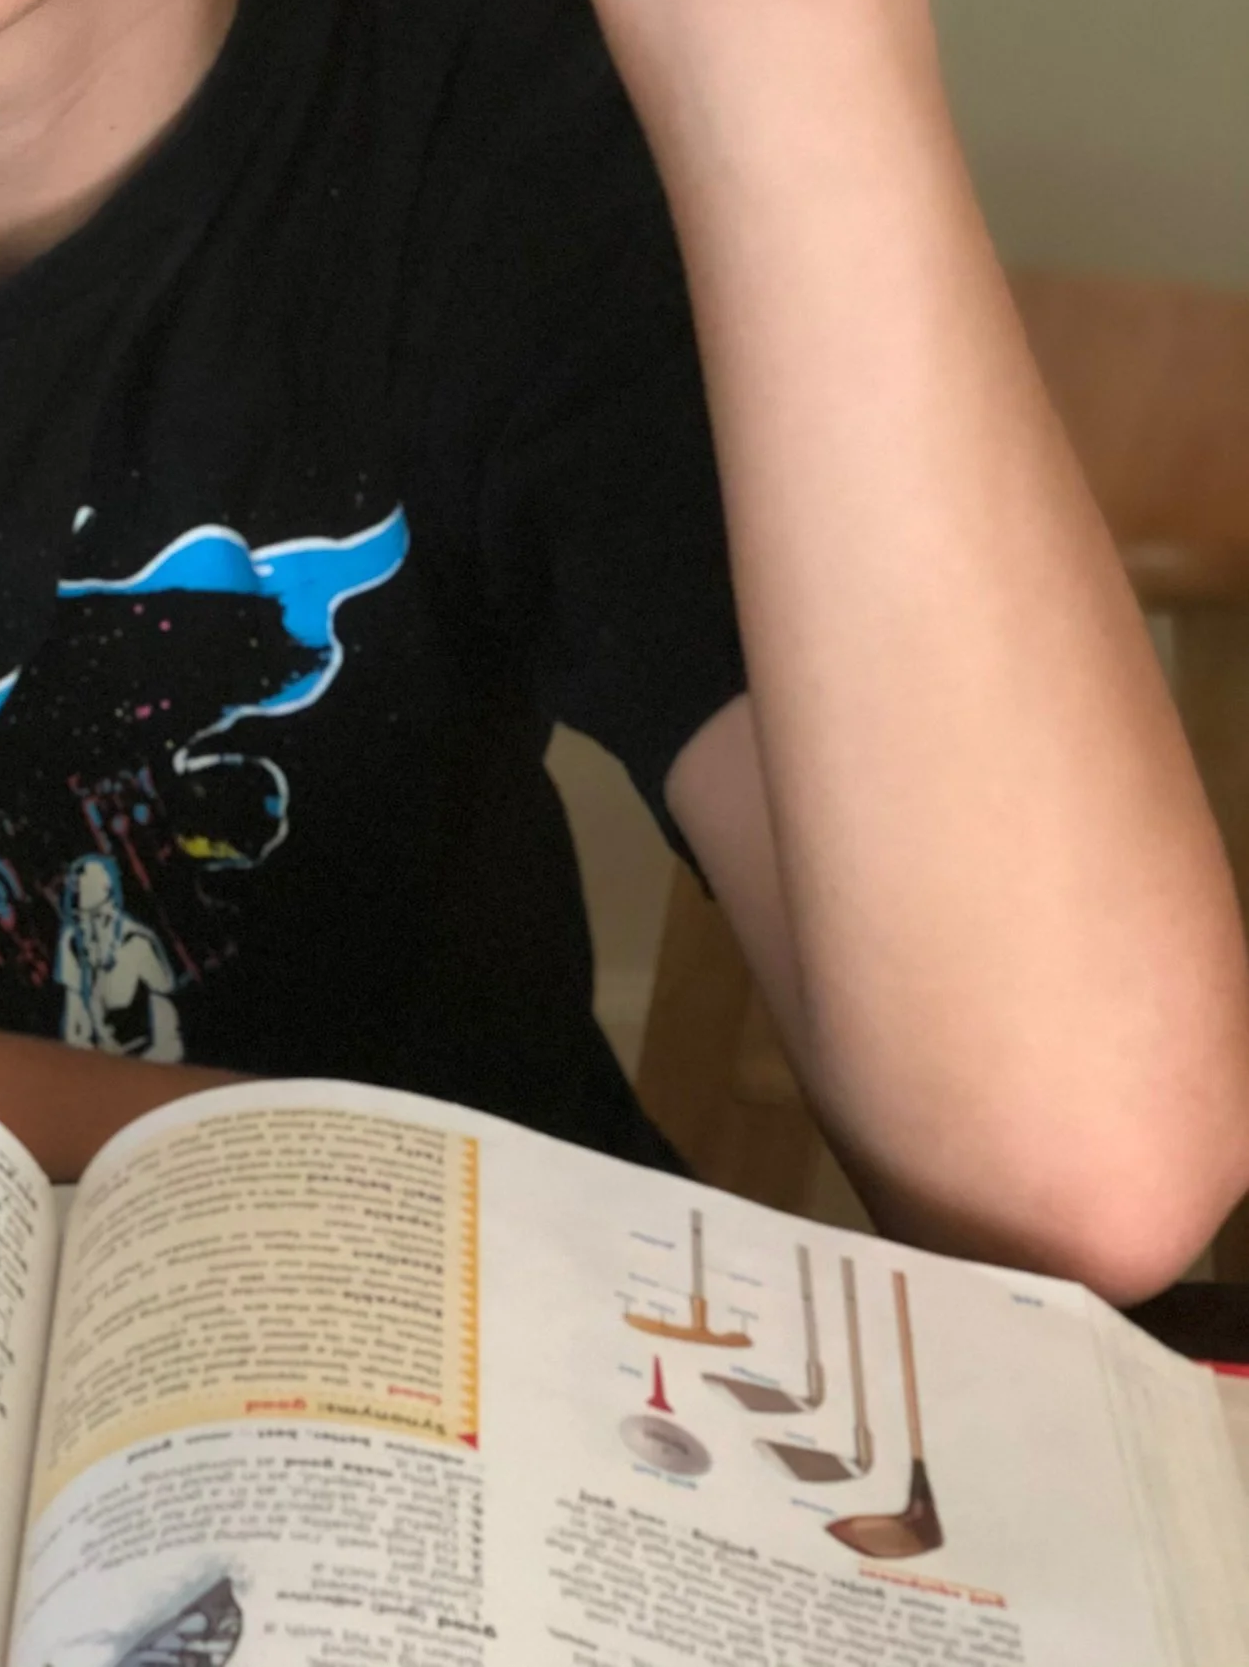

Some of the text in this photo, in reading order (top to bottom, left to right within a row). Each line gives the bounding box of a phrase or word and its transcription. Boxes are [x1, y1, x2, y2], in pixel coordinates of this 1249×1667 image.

[342, 1292, 443, 1318] Enjoyable
[387, 1385, 442, 1406] Good
[244, 1398, 447, 1437] Synonyms: good
[437, 1617, 497, 1638] good
